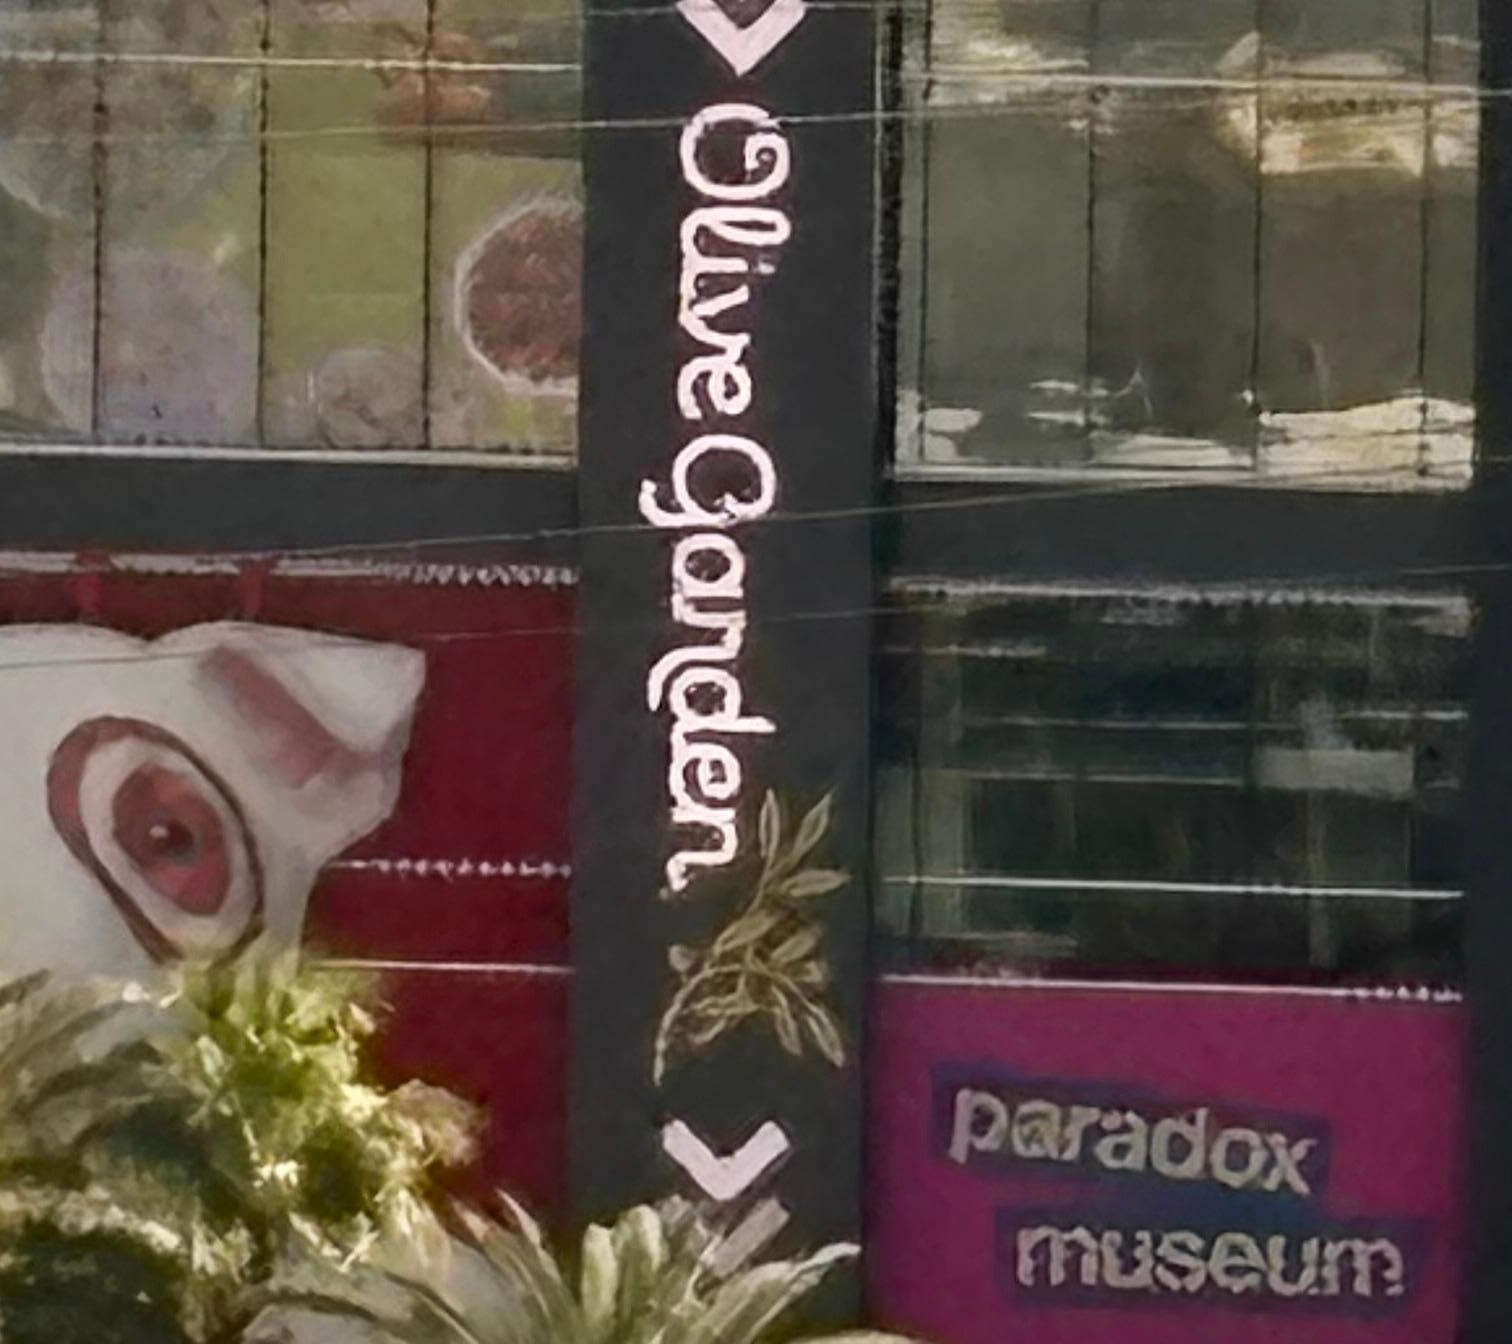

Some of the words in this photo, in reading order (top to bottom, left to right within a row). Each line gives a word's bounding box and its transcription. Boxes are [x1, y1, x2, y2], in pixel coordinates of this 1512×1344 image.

[678, 101, 792, 420] Olive
[638, 433, 777, 893] Garden
[948, 1086, 1319, 1197] paradox
[1014, 1222, 1405, 1297] museum
